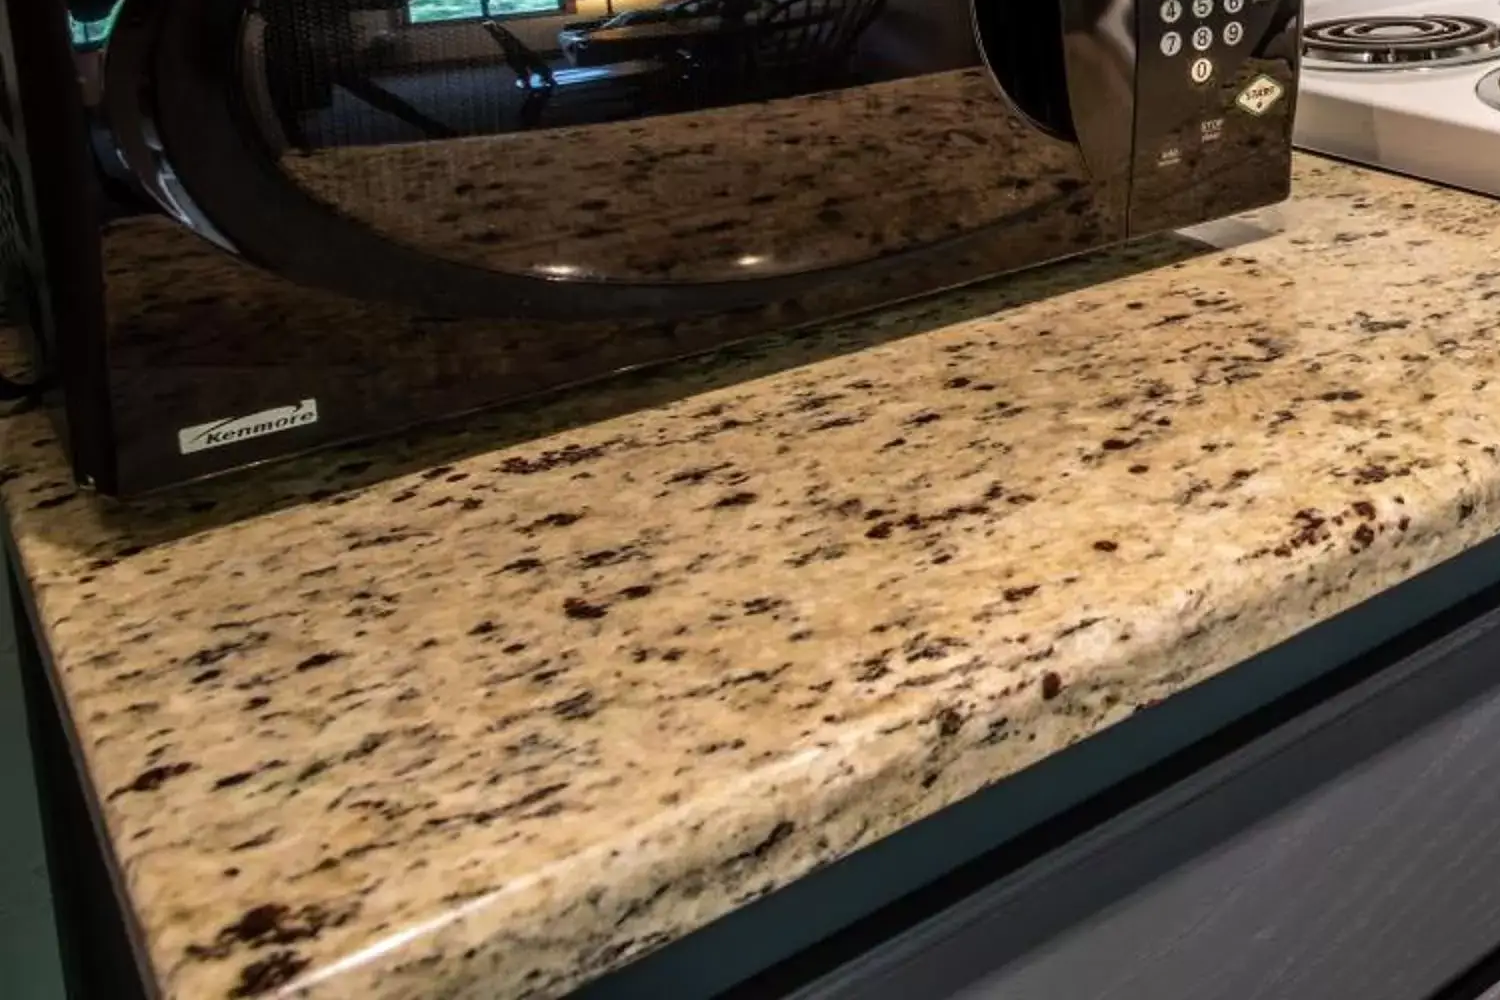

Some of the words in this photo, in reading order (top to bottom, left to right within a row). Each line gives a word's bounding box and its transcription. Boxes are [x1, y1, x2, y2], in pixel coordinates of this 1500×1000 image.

[1166, 1, 1176, 19] 4
[1166, 35, 1176, 53] 7
[1197, 29, 1207, 47] 8
[1228, 24, 1238, 42] 9
[1197, 61, 1207, 79] 0
[206, 411, 314, 445] Kenmore
